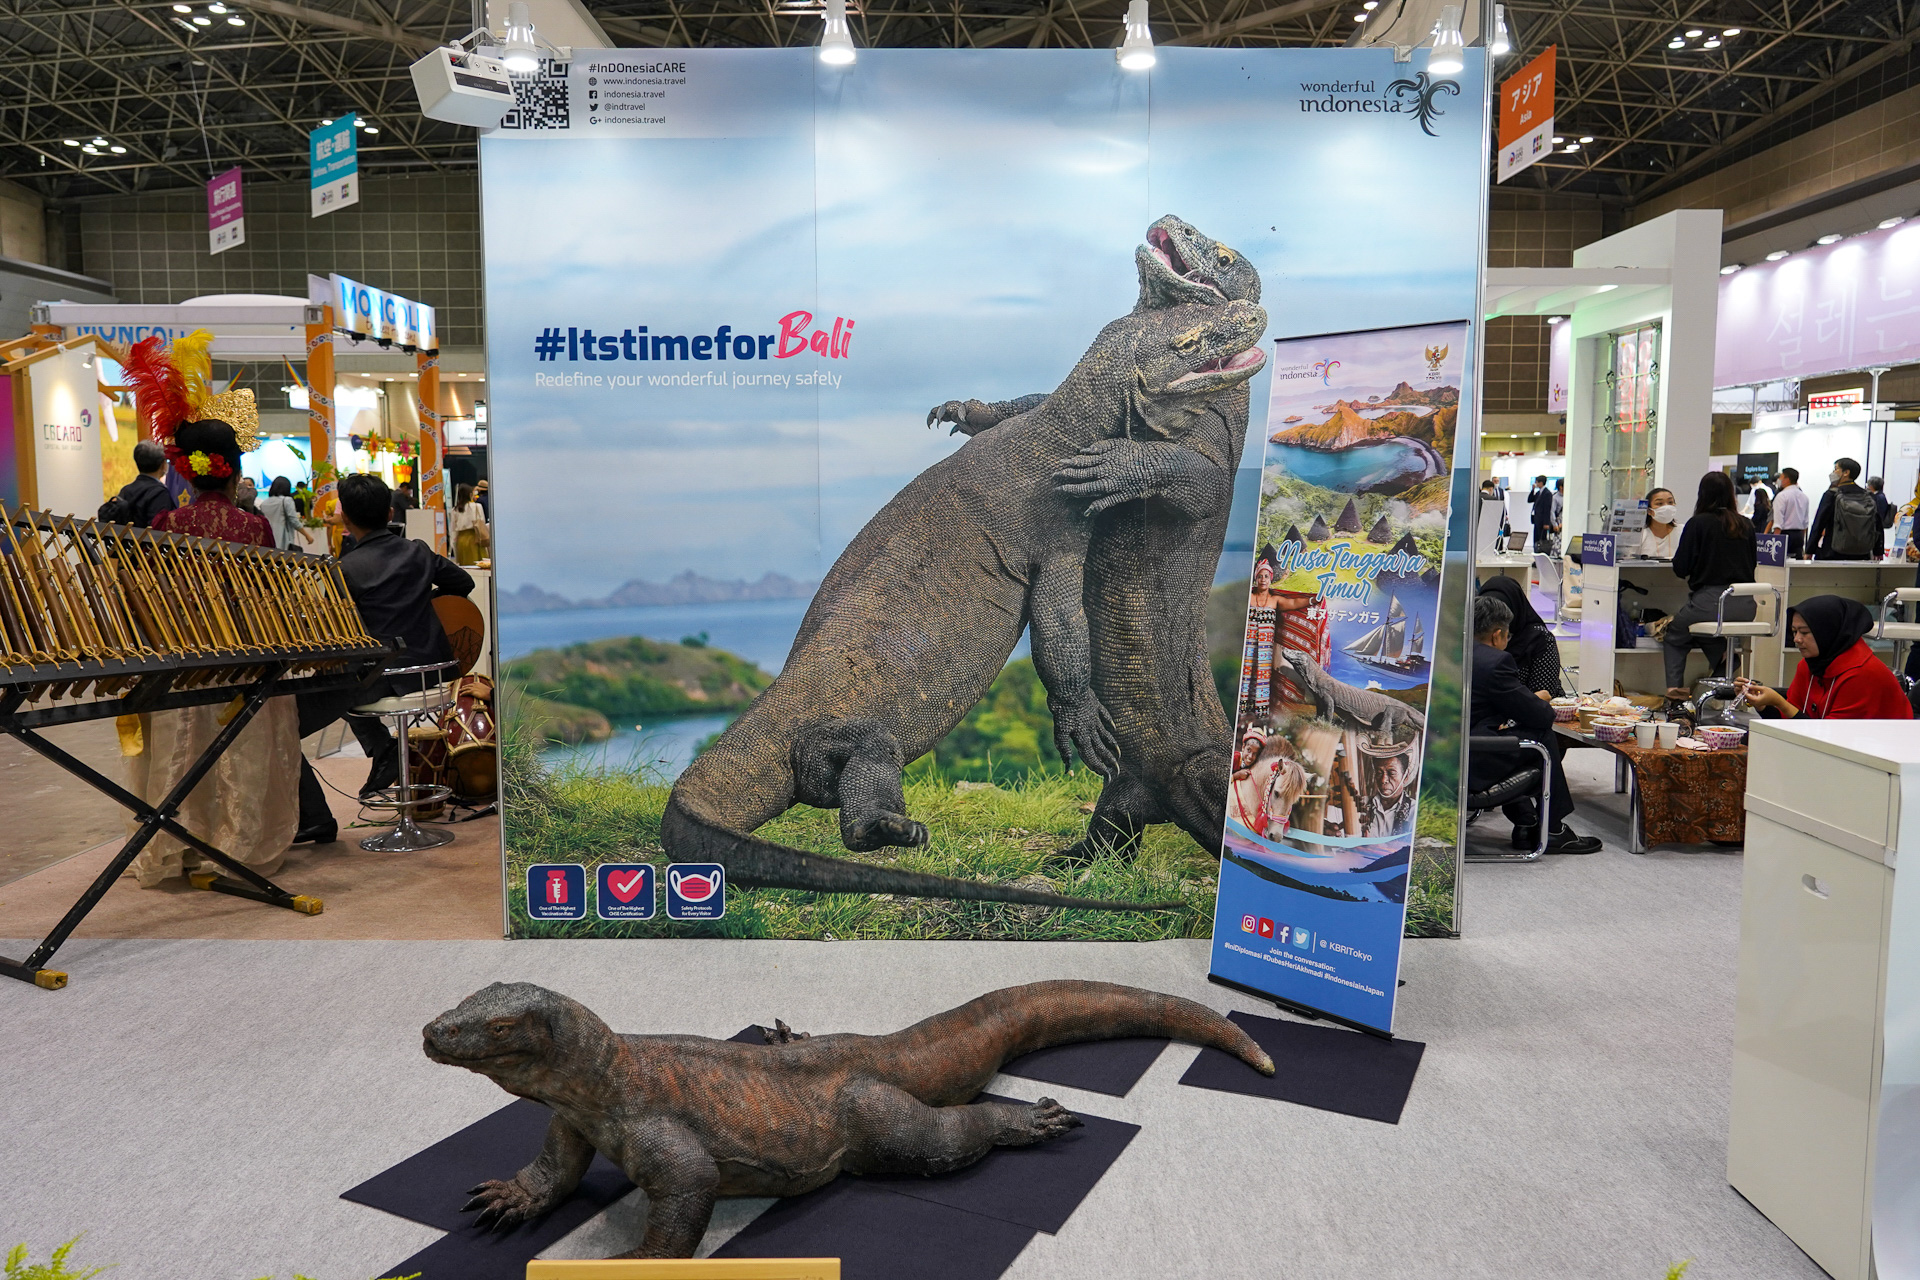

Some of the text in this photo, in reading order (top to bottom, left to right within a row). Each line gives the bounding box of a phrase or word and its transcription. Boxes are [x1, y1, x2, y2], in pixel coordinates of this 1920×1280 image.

[589, 62, 686, 73] #InDOnesiaCARE
[603, 77, 686, 85] www.indonesia.travel
[1300, 80, 1375, 93] wonderful
[604, 90, 665, 98] indonesia.travel
[1511, 72, 1543, 112] アジア
[604, 103, 646, 112] @indtravel
[1299, 94, 1403, 113] indonesia
[604, 116, 666, 124] indonesia.travel
[1520, 110, 1533, 125] Asia
[1281, 364, 1309, 372] wonderful
[535, 370, 842, 391] Redefine your wonderful journey safely
[1280, 371, 1318, 381] indonesia
[1584, 545, 1602, 553] indonesia
[1277, 540, 1426, 579] Nusa Tenggara
[1316, 572, 1372, 606] Timur
[1306, 607, 1380, 625] 東ヌサテンガラ
[1319, 940, 1373, 962] @ KBRITokyo
[1269, 947, 1336, 973] Join the conversation:
[1224, 942, 1385, 997] #IniDiplomasi #DubesHeriAkhmadi #IndonesiainJapan
